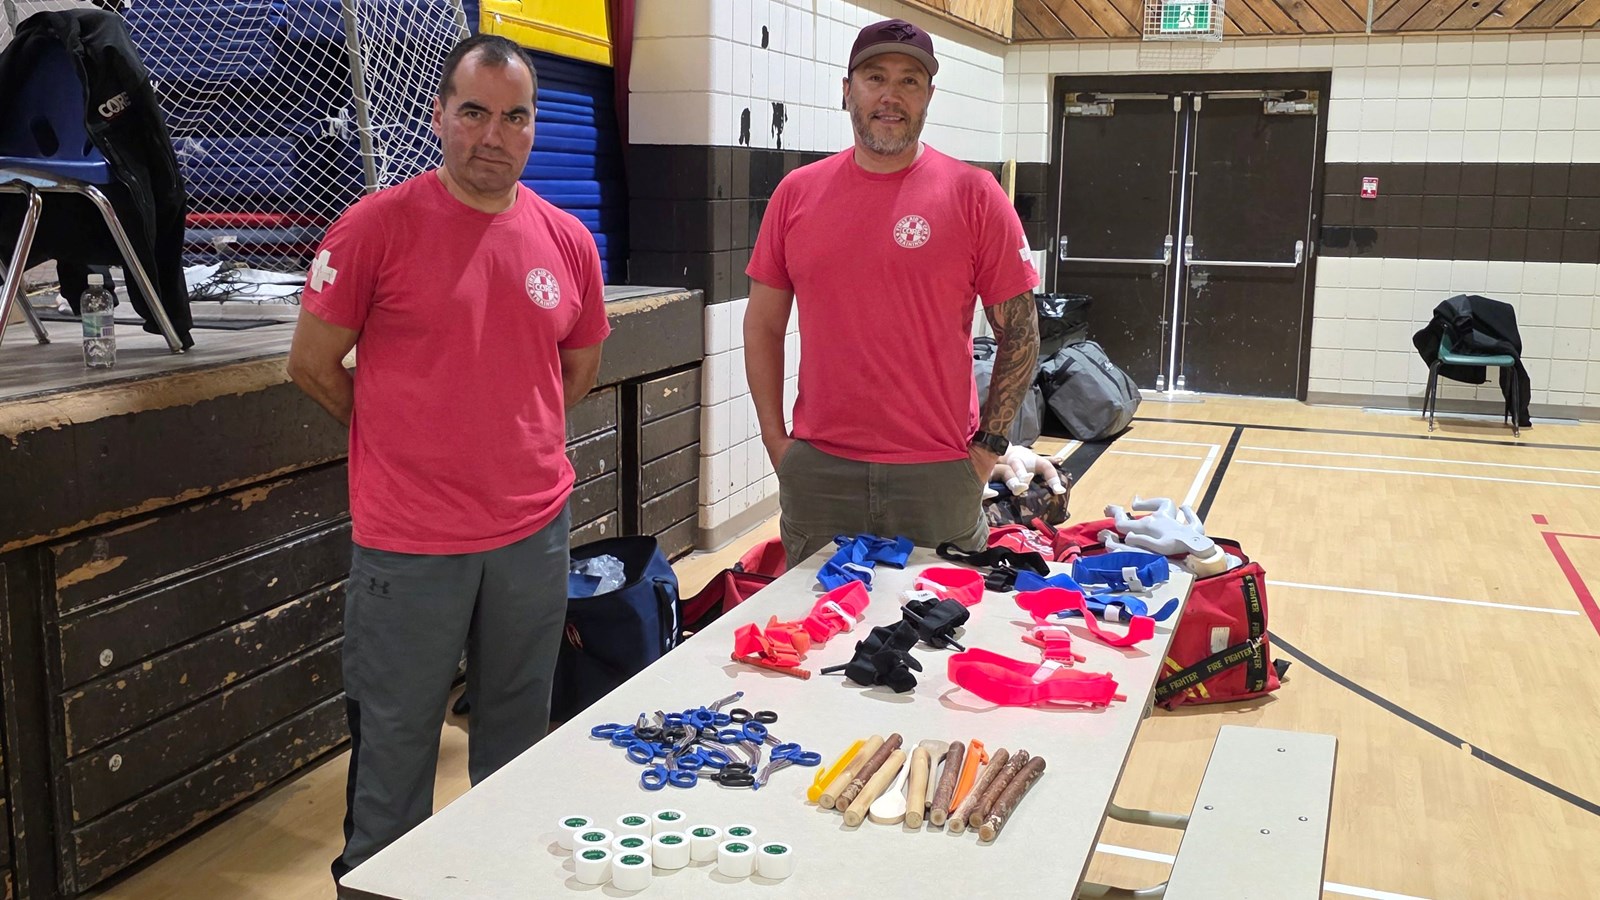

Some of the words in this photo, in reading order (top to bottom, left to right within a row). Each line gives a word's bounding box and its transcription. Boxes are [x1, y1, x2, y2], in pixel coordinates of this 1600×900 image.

[98, 91, 131, 118] CORE
[902, 227, 922, 237] CORE
[534, 283, 553, 293] CORE
[1248, 582, 1260, 613] FIGHTER
[1206, 660, 1223, 673] FIRE
[1223, 647, 1252, 664] FIGHTER
[1169, 671, 1199, 690] FIGHTER
